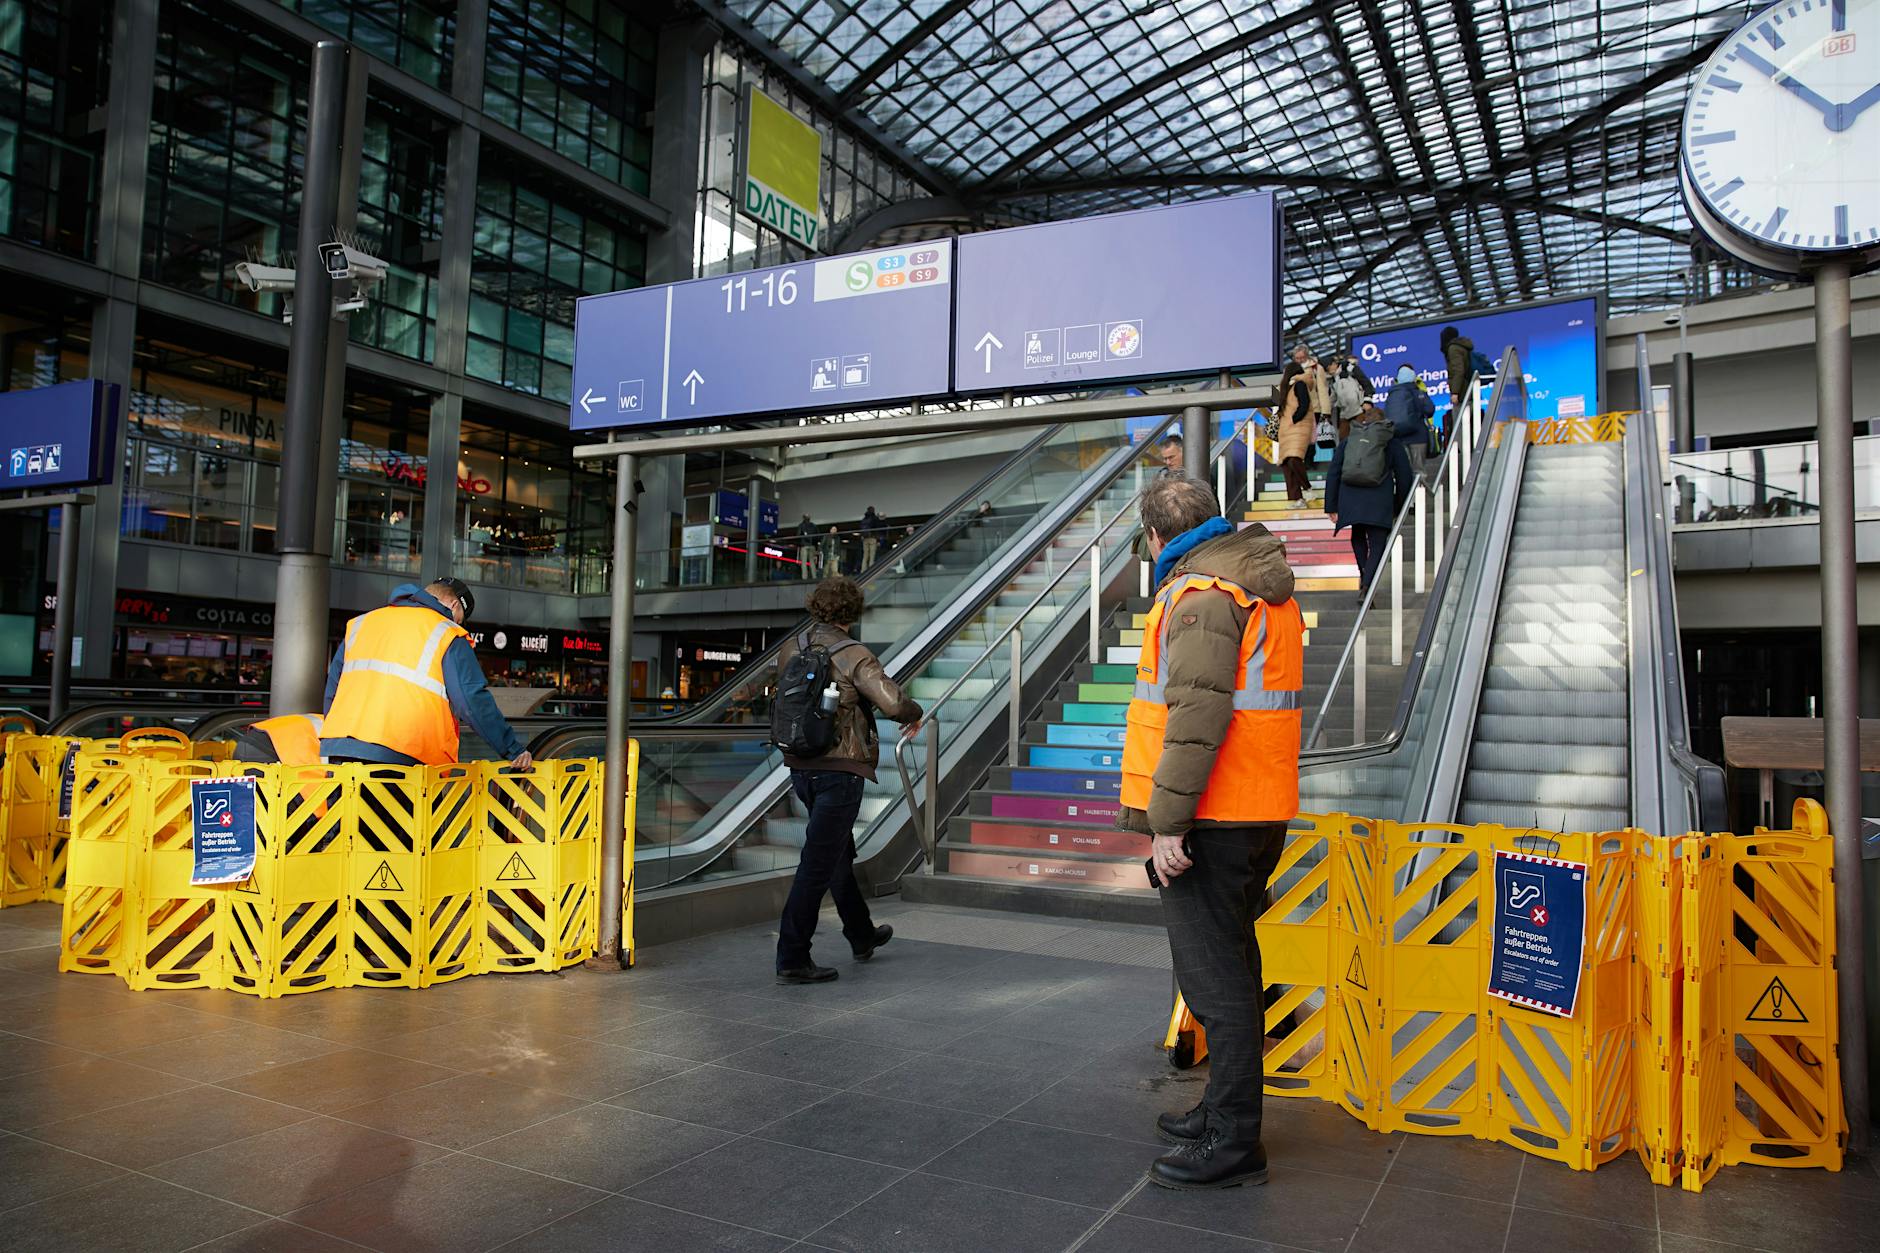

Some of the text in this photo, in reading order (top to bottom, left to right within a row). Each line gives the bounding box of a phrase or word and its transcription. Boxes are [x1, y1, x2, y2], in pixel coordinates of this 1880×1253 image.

[1828, 38, 1850, 54] DB
[746, 180, 817, 245] DATEV
[721, 269, 798, 312] 11-16
[1066, 350, 1098, 360] Lounge
[1397, 344, 1407, 353] do
[1026, 353, 1054, 365] Polizei
[1370, 374, 1394, 389] Wir
[620, 394, 638, 409] WC
[219, 407, 276, 442] PINSA
[196, 608, 246, 624] COSTA
[704, 650, 726, 661] BURGER
[727, 653, 741, 662] KING
[201, 831, 233, 839] Fahrtreppen
[218, 838, 236, 846] Betrieb
[1504, 925, 1548, 943] Fahrtreppen
[1504, 937, 1552, 955] außer Betrieb
[1503, 947, 1529, 960] Escalators
[1530, 954, 1538, 962] out
[1538, 956, 1545, 965] of
[1545, 959, 1559, 967] order
